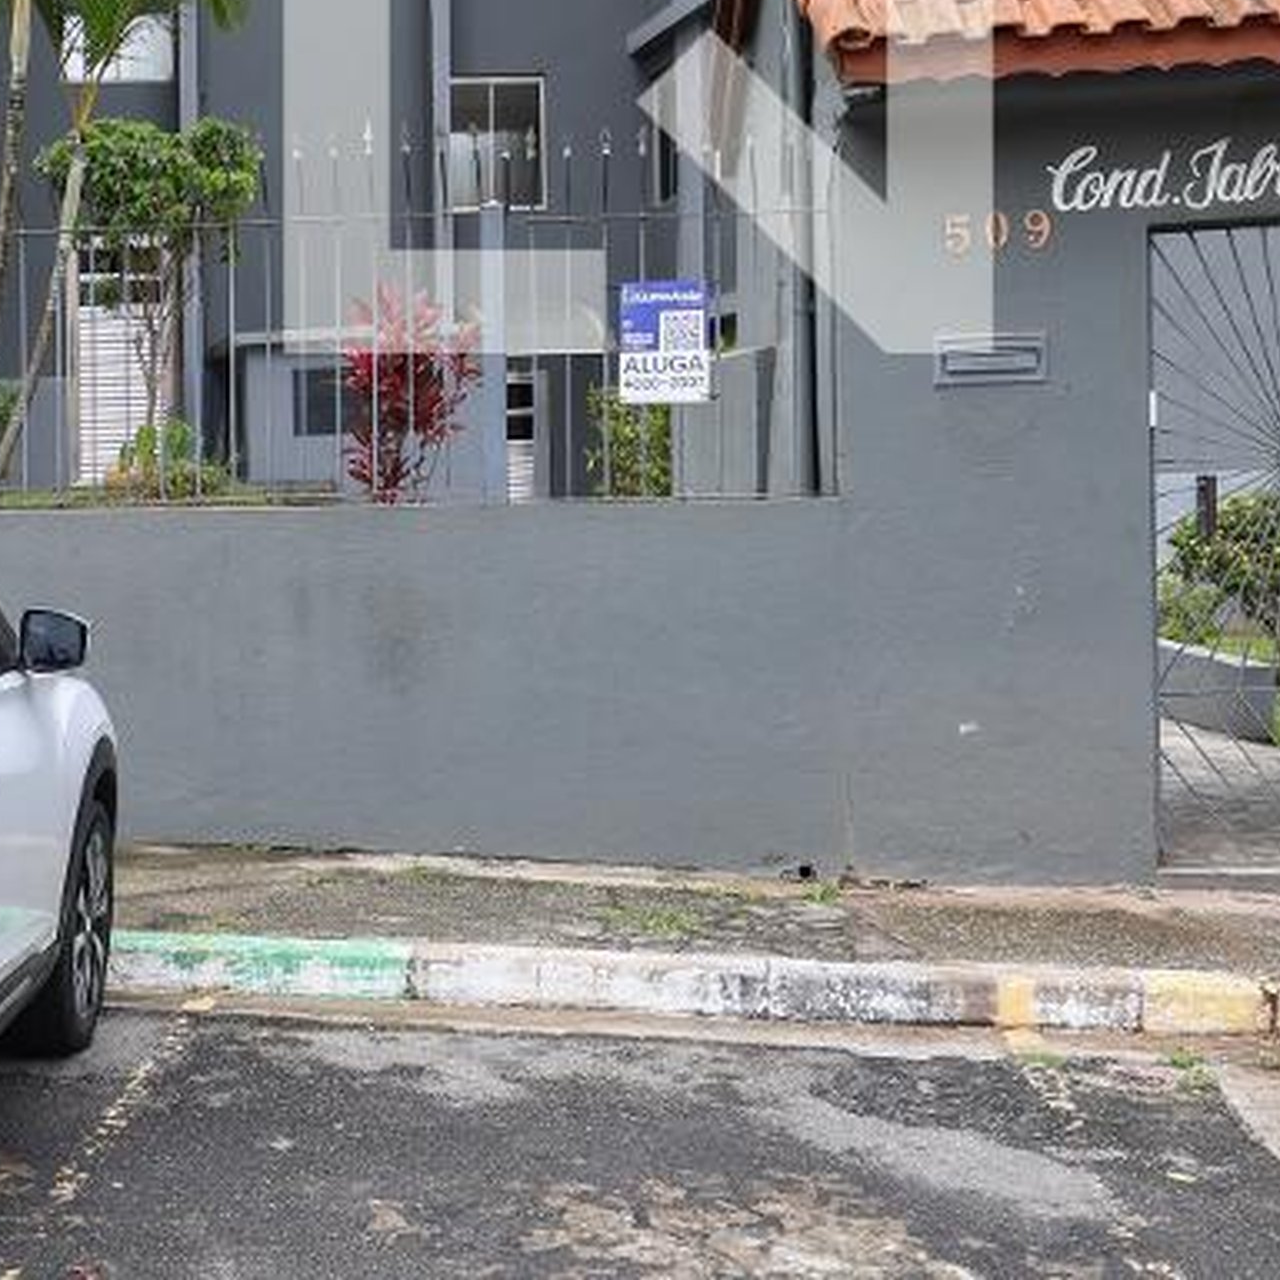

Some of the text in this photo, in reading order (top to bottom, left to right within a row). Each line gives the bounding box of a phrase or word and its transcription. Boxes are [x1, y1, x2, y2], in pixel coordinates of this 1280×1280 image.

[1045, 144, 1182, 212] Cond.
[942, 209, 1053, 256] 509
[622, 354, 705, 375] ALUGA
